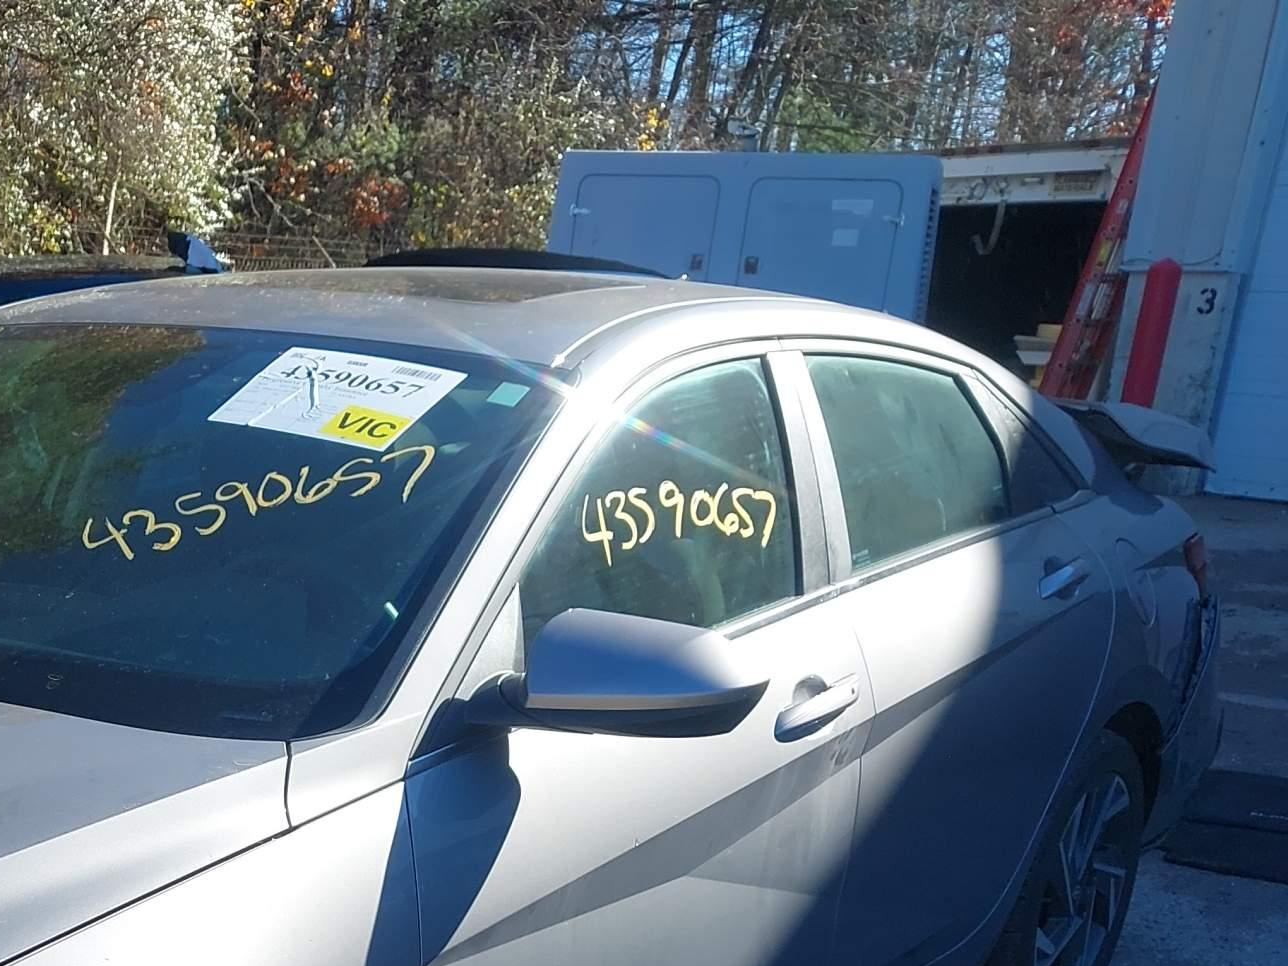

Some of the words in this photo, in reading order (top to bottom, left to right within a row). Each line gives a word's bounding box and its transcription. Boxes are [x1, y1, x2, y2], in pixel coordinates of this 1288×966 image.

[1196, 287, 1218, 315] 3
[337, 411, 397, 439] VIC
[81, 444, 436, 560] 43590657
[581, 479, 777, 567] 43590657
